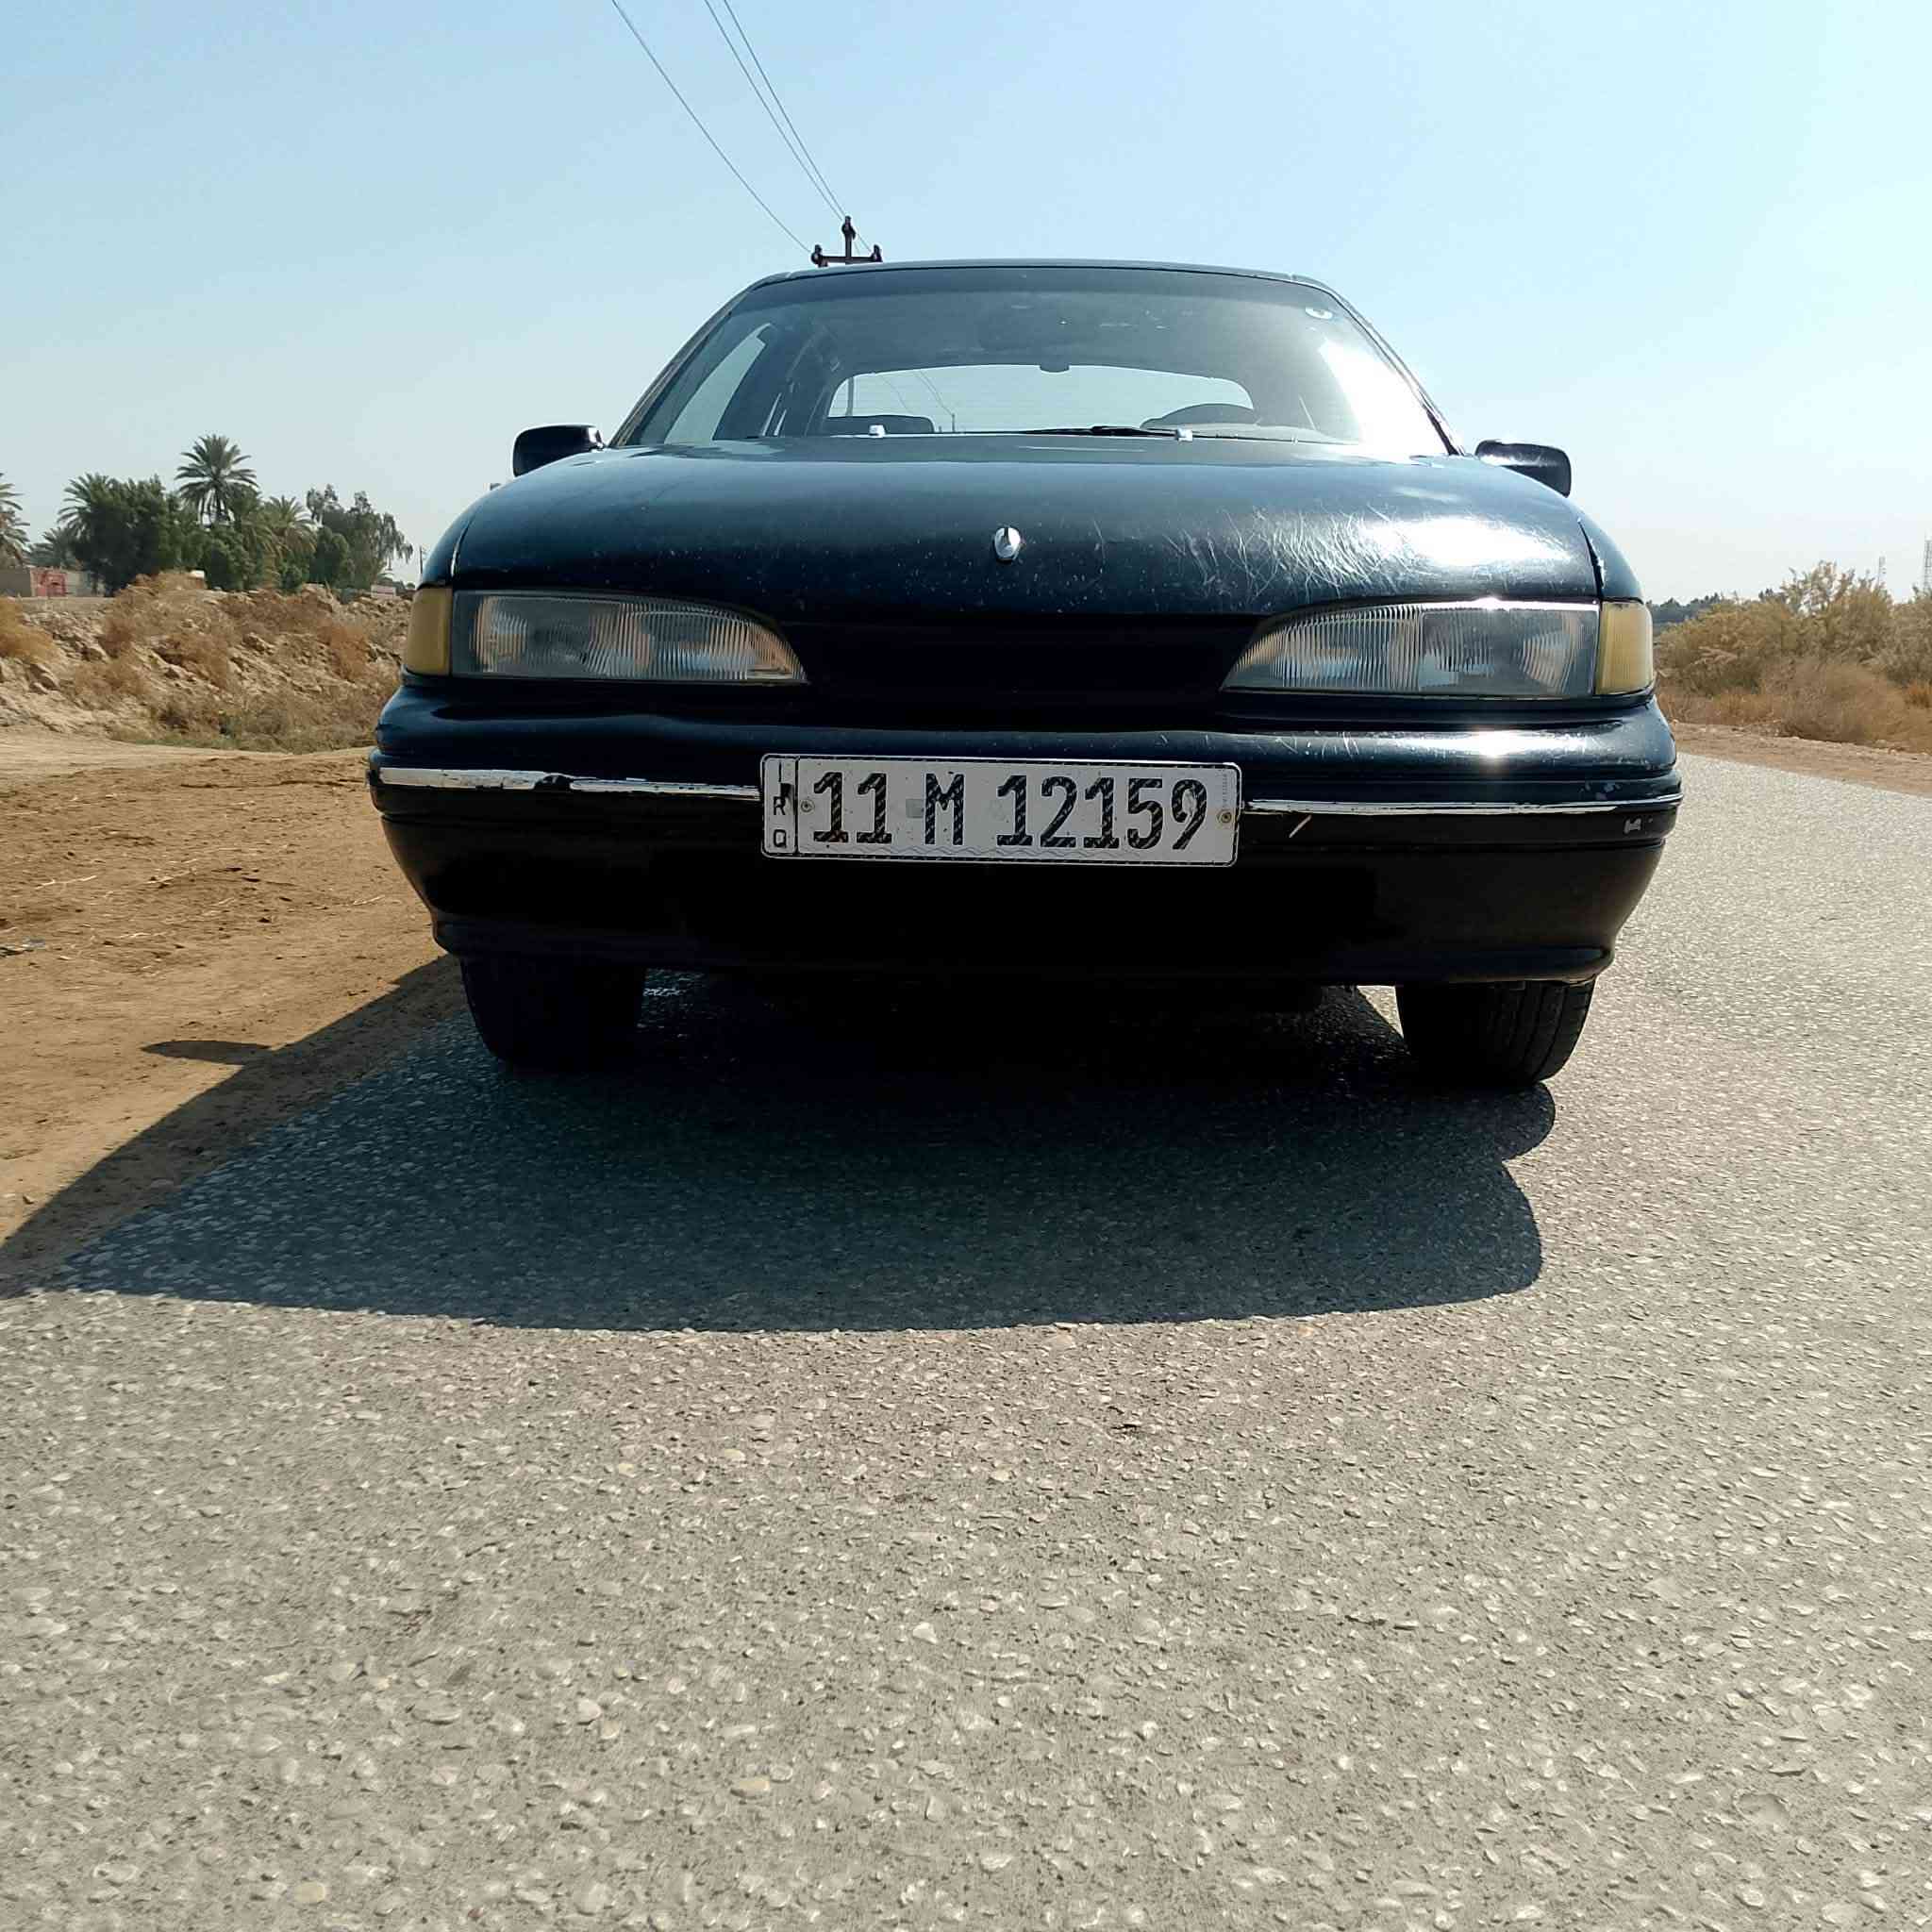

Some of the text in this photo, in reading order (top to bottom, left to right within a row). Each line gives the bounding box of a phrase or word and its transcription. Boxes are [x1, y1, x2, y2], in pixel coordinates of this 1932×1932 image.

[813, 772, 892, 843] 11
[924, 773, 964, 846] M
[996, 774, 1208, 850] 12159
